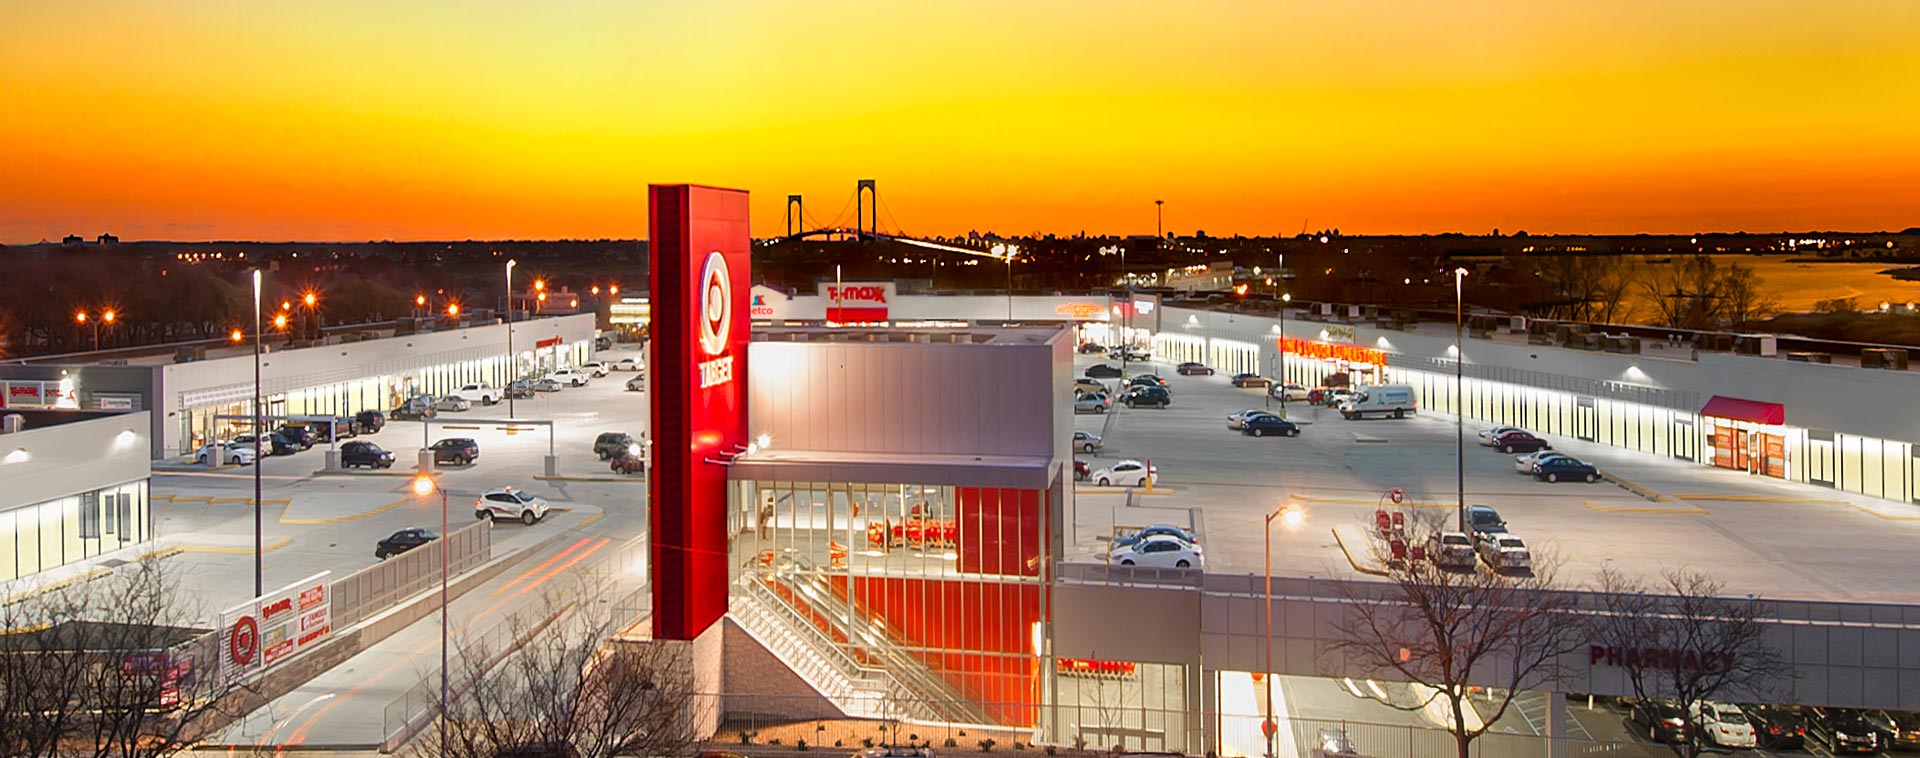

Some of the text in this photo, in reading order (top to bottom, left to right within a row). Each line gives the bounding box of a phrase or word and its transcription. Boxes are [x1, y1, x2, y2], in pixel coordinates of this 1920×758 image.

[751, 306, 773, 315] etco
[698, 355, 734, 389] TARGET
[1590, 644, 1736, 672] PHARMACY
